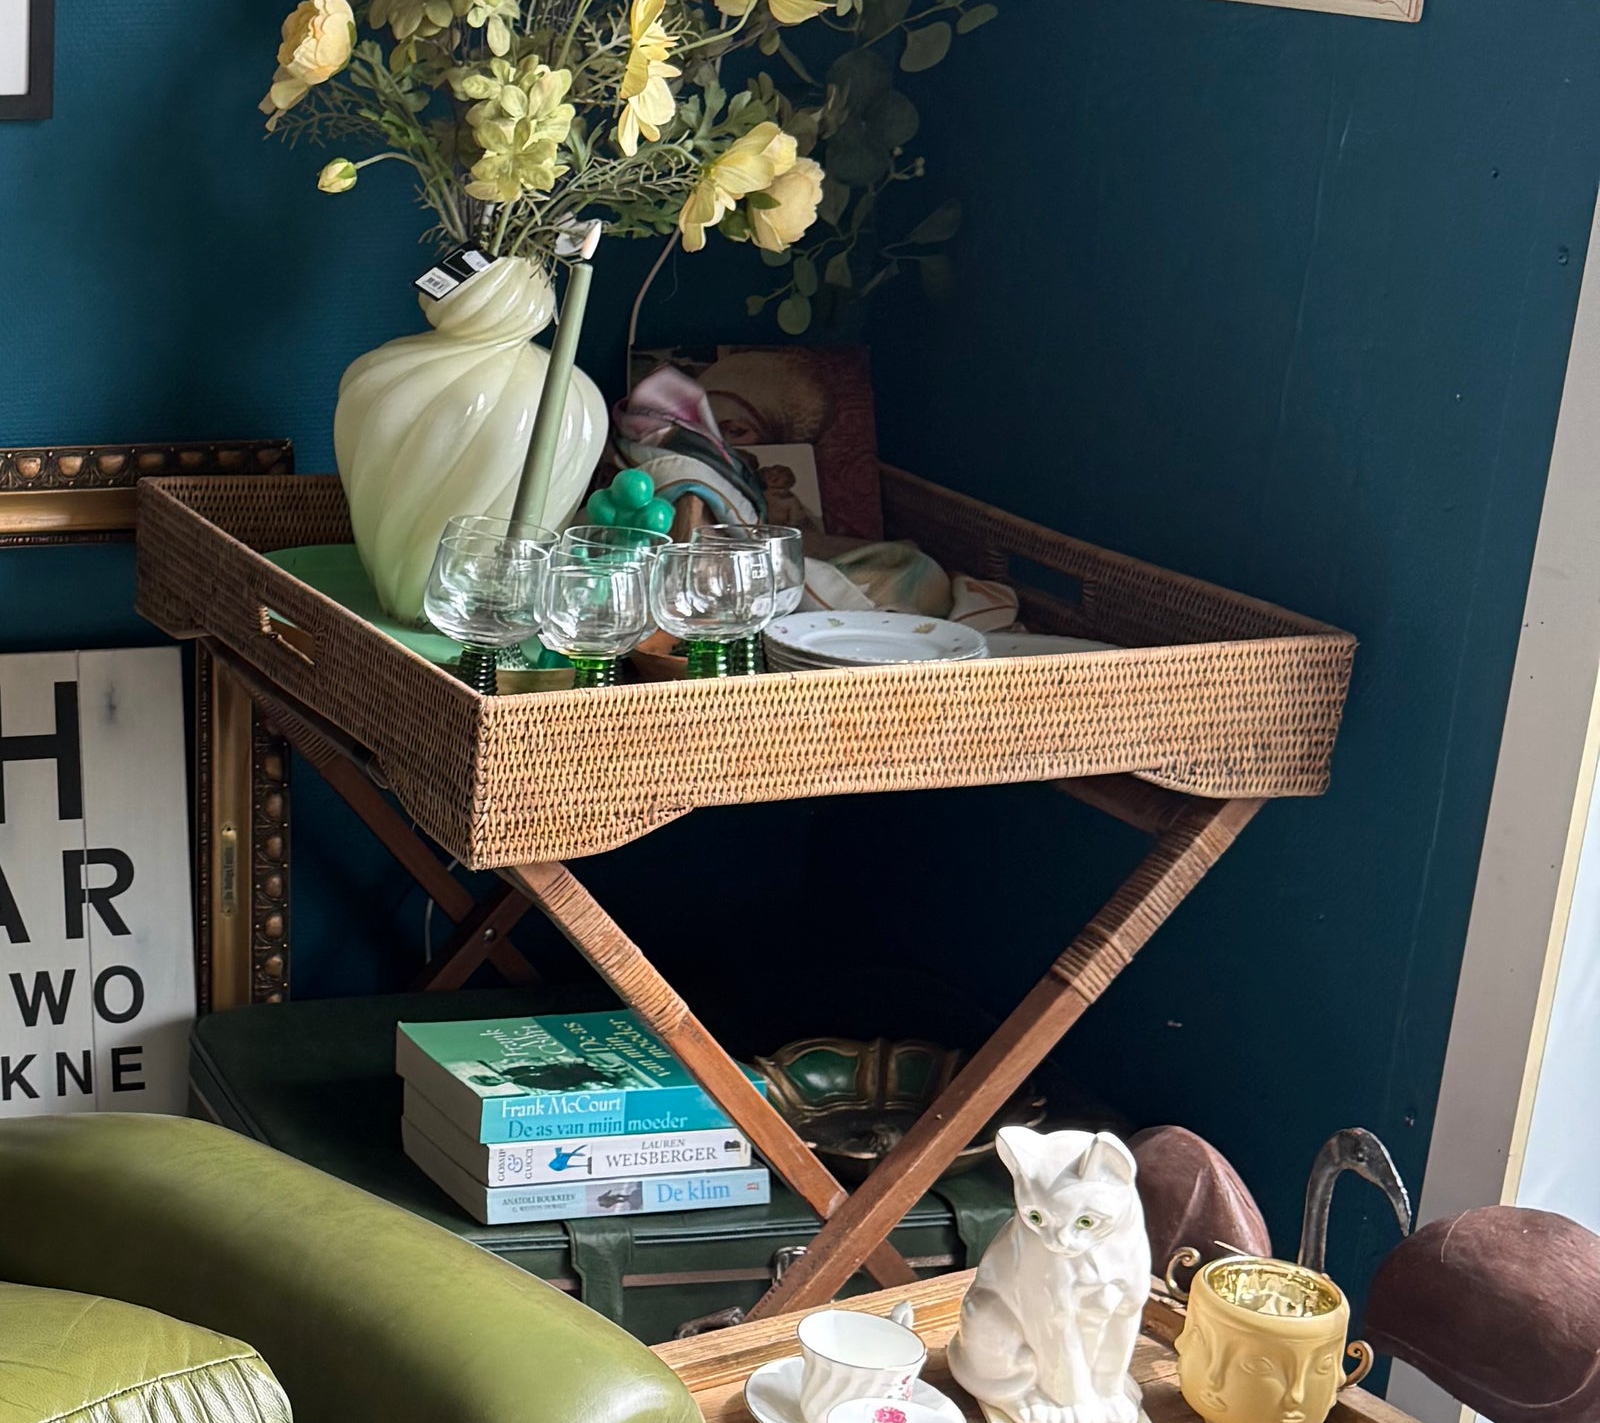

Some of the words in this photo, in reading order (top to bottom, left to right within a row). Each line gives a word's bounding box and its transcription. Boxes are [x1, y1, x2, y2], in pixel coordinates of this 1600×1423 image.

[563, 1022, 588, 1034] as
[609, 1018, 671, 1059] moeder
[480, 1028, 529, 1057] Frank
[579, 1035, 610, 1052] De
[605, 1036, 645, 1059] mijn
[638, 1059, 671, 1077] van
[502, 1097, 544, 1118] Frank
[548, 1096, 621, 1115] McCourt
[509, 1120, 532, 1139] De
[536, 1125, 552, 1137] as
[557, 1123, 583, 1135] van
[588, 1118, 622, 1134] mijn
[628, 1111, 688, 1131] moeder
[641, 1139, 685, 1151] LAUREN
[525, 1148, 533, 1180] GUCCI
[606, 1147, 717, 1167] WEISBERGER
[502, 1196, 535, 1206] ANATOLI
[657, 1184, 683, 1203] De
[688, 1179, 731, 1201] klim
